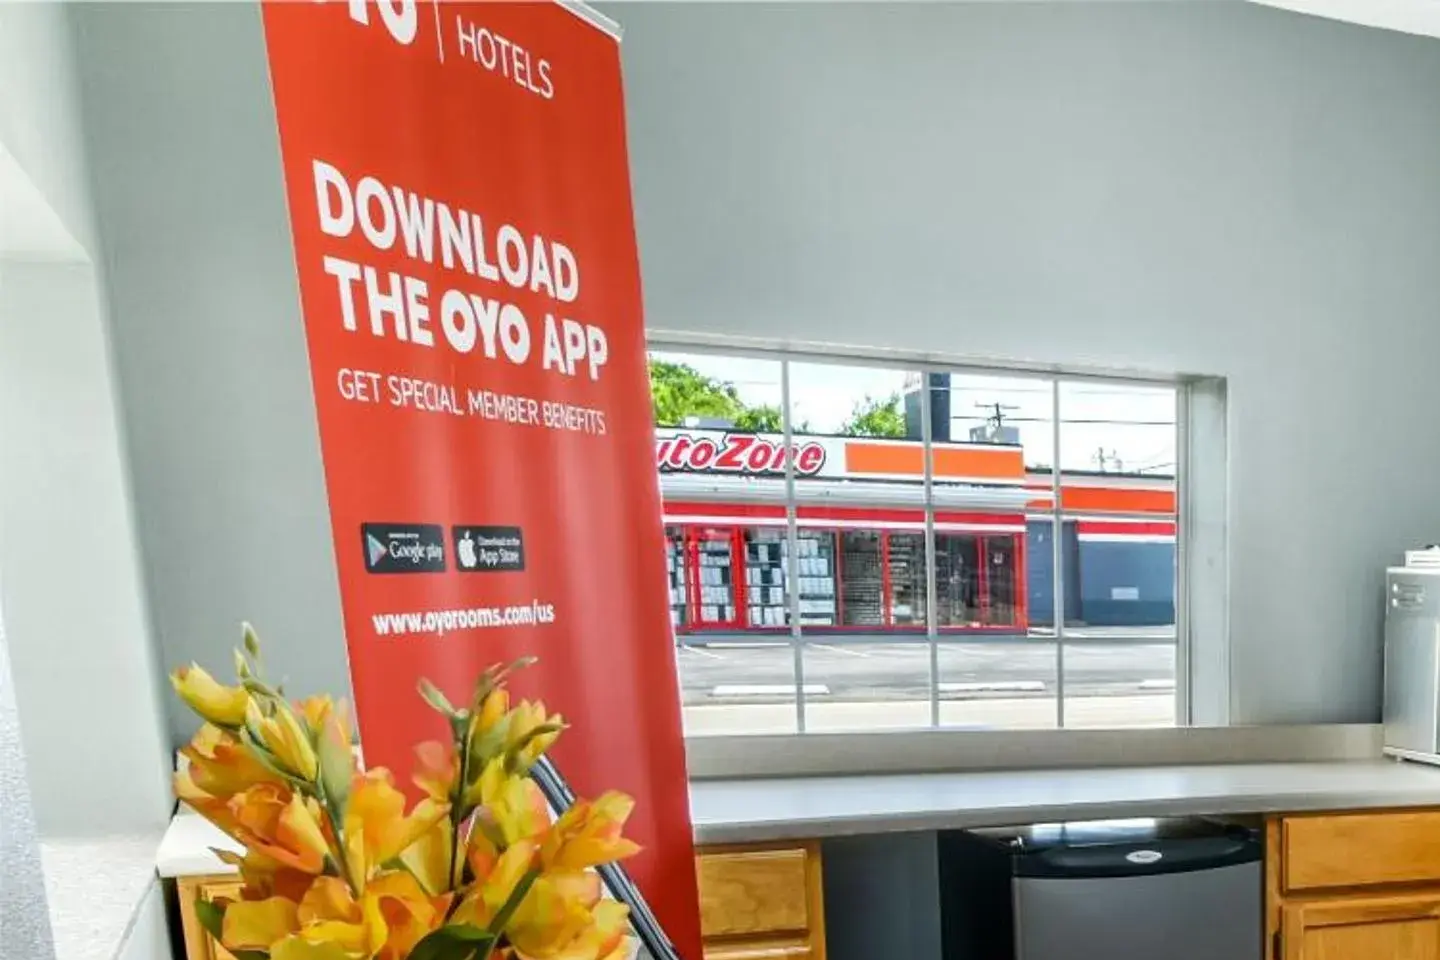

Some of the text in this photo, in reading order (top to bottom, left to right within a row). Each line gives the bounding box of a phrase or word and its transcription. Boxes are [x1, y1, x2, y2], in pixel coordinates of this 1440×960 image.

[457, 14, 554, 99] HOTELS
[312, 159, 579, 303] DOWNLOAD
[323, 256, 608, 381] THE OYO APP
[337, 368, 606, 435] GET SPECIAL MEMBER BENEFITS
[656, 434, 826, 474] utoZone
[389, 541, 425, 563] Google
[480, 548, 520, 566] App Store
[372, 599, 555, 637] www.oyorooms.com/us
